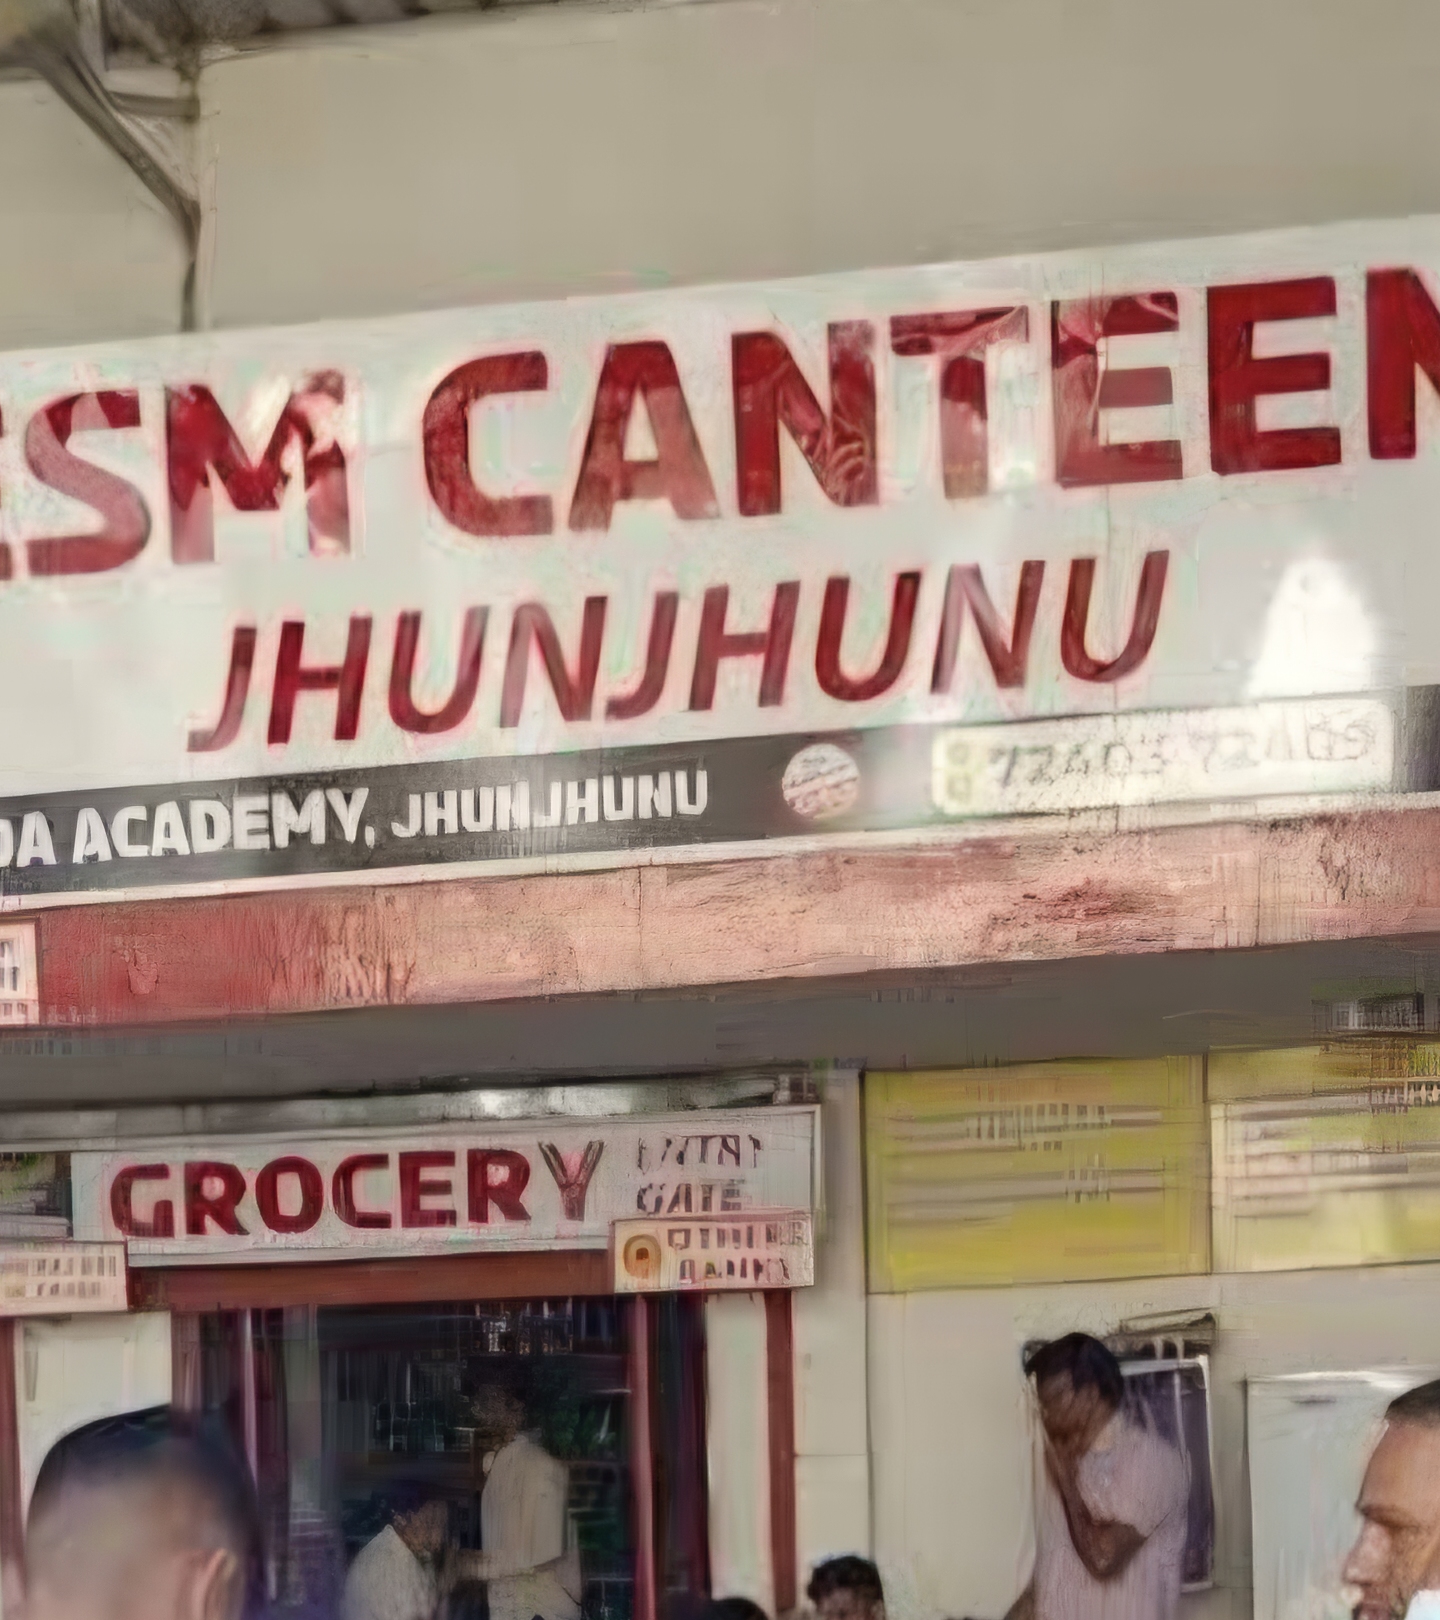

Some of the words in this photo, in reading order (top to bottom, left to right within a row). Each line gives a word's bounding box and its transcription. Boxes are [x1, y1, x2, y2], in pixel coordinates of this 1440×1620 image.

[186, 551, 1169, 752] JHUNJHUNU
[72, 787, 375, 865] ACADEMY,
[390, 769, 707, 837] JHUNJHUNU
[109, 1140, 605, 1237] GROCERY
